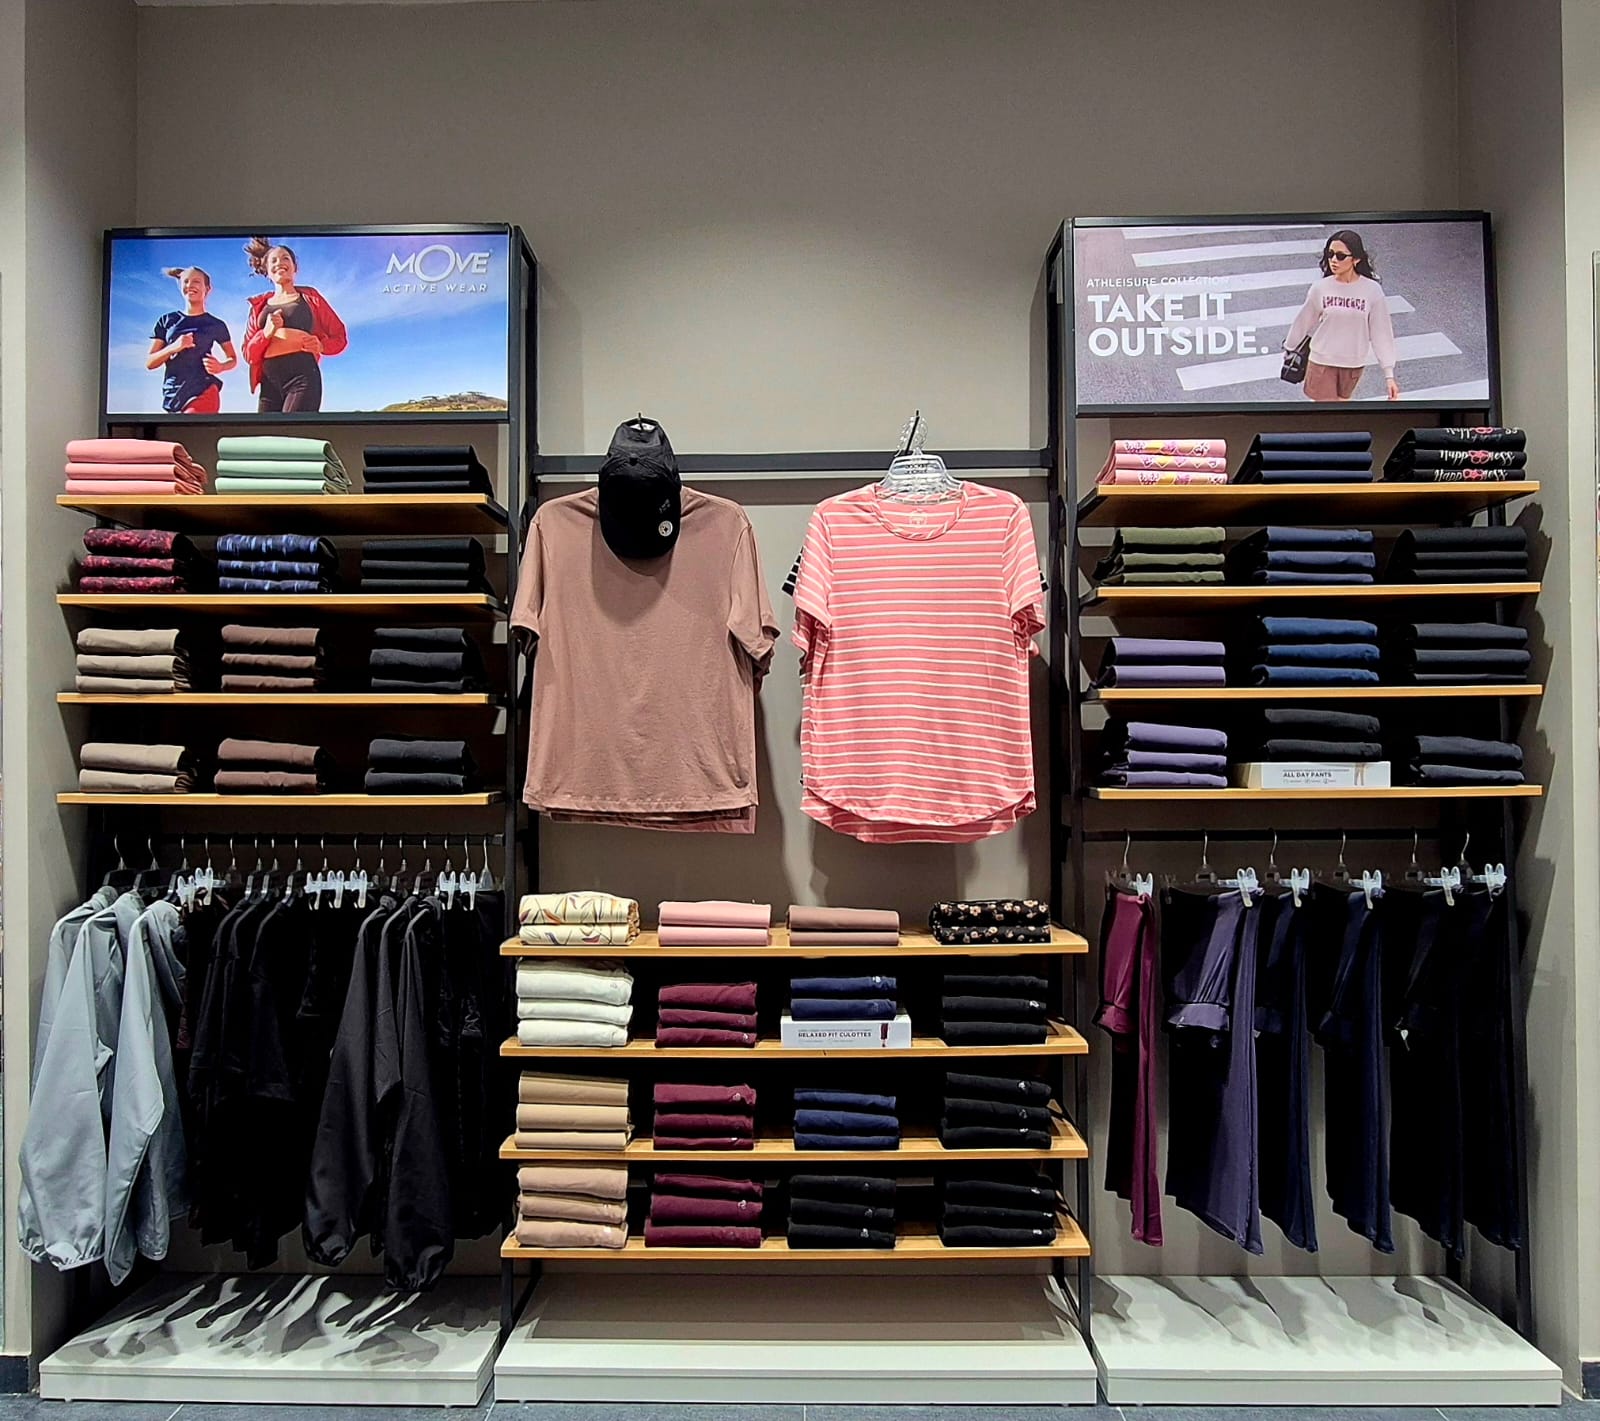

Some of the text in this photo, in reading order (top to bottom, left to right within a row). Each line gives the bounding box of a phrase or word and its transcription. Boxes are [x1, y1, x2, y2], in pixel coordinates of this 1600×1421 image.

[386, 244, 490, 282] MOVE
[383, 283, 488, 293] ACTIVE WEAR
[1086, 277, 1157, 288] ATHLEISURE
[1087, 292, 1232, 323] TAKE IT
[1088, 326, 1270, 357] OUTSIDE.
